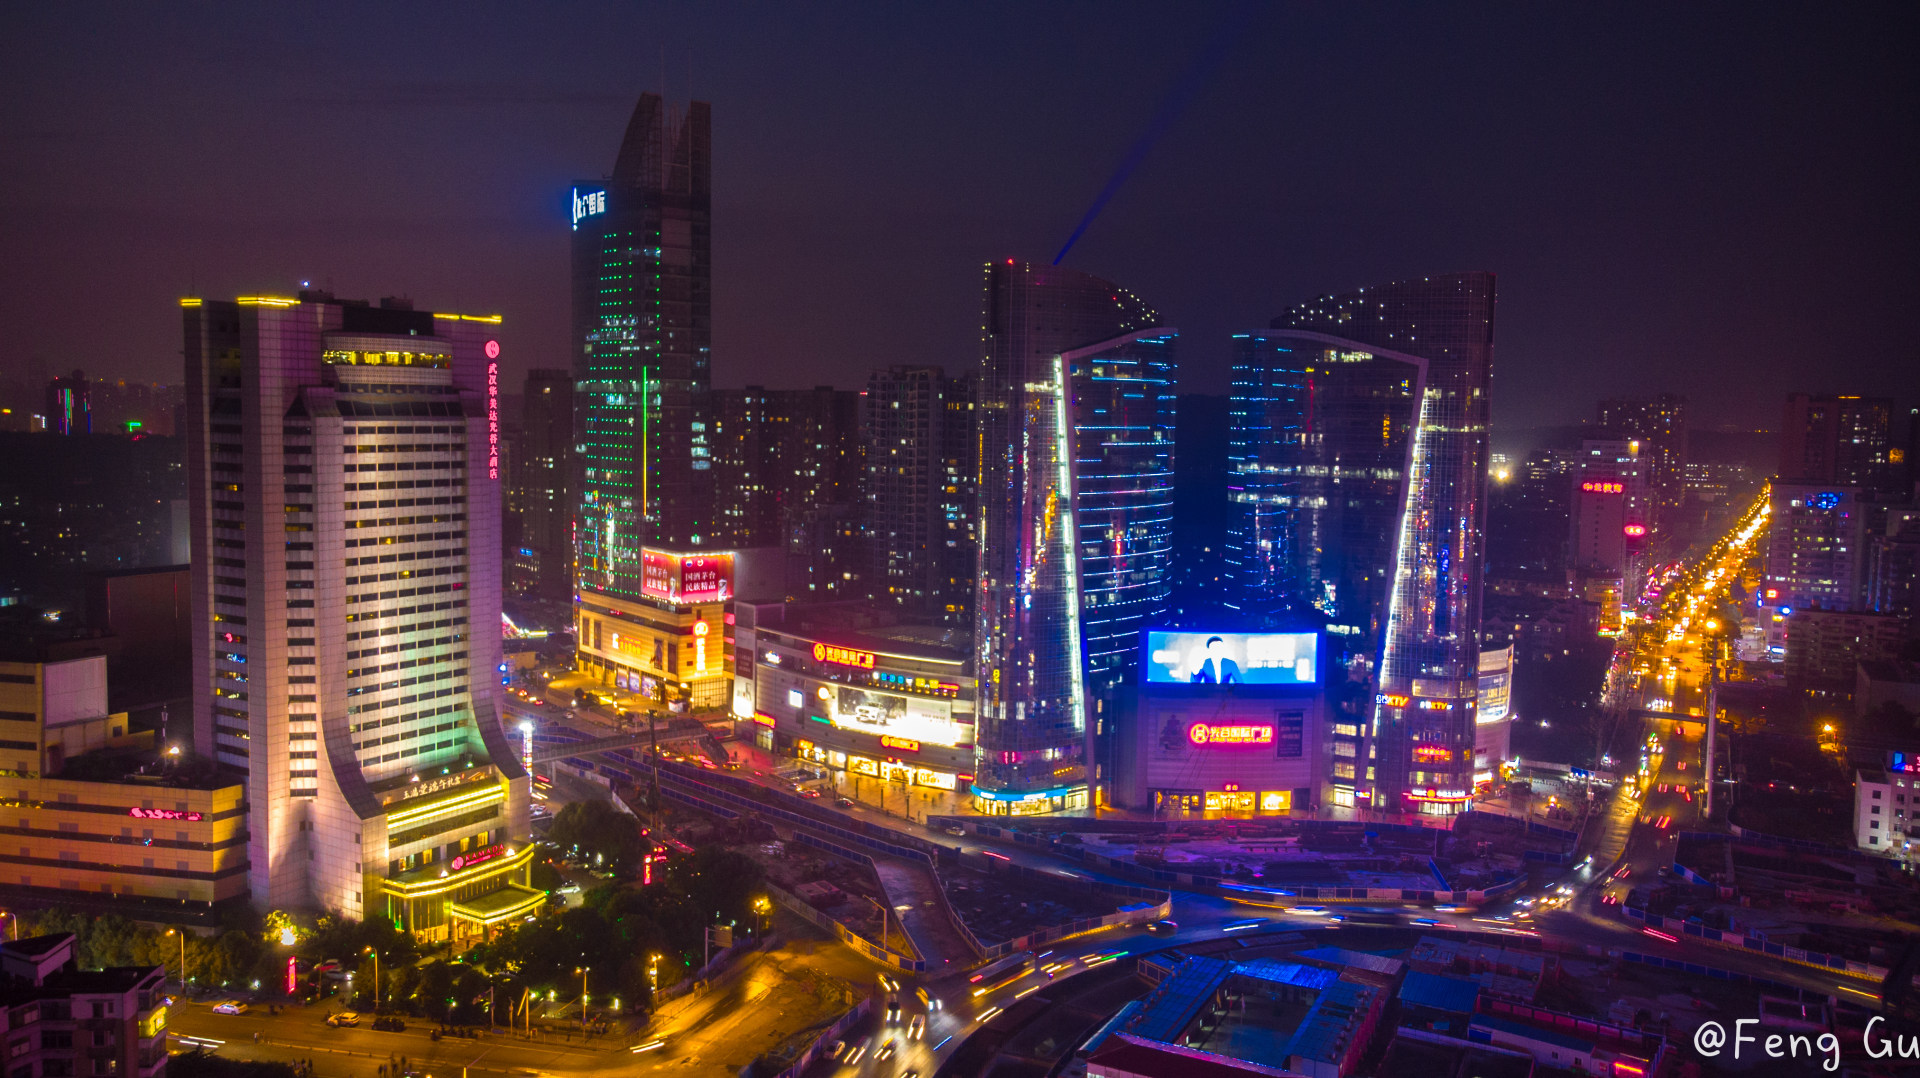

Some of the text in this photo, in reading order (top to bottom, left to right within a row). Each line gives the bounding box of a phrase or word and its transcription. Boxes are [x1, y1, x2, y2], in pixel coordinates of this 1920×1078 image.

[488, 362, 498, 479] 武汉华美达光谷大酒店
[646, 565, 668, 579] 国酒茅台
[685, 571, 716, 581] 国酒茅台
[646, 578, 668, 592] 民族精品
[685, 581, 716, 592] 民族精品
[1209, 726, 1273, 738] 光谷国际广场
[465, 843, 504, 861] RAMADA
